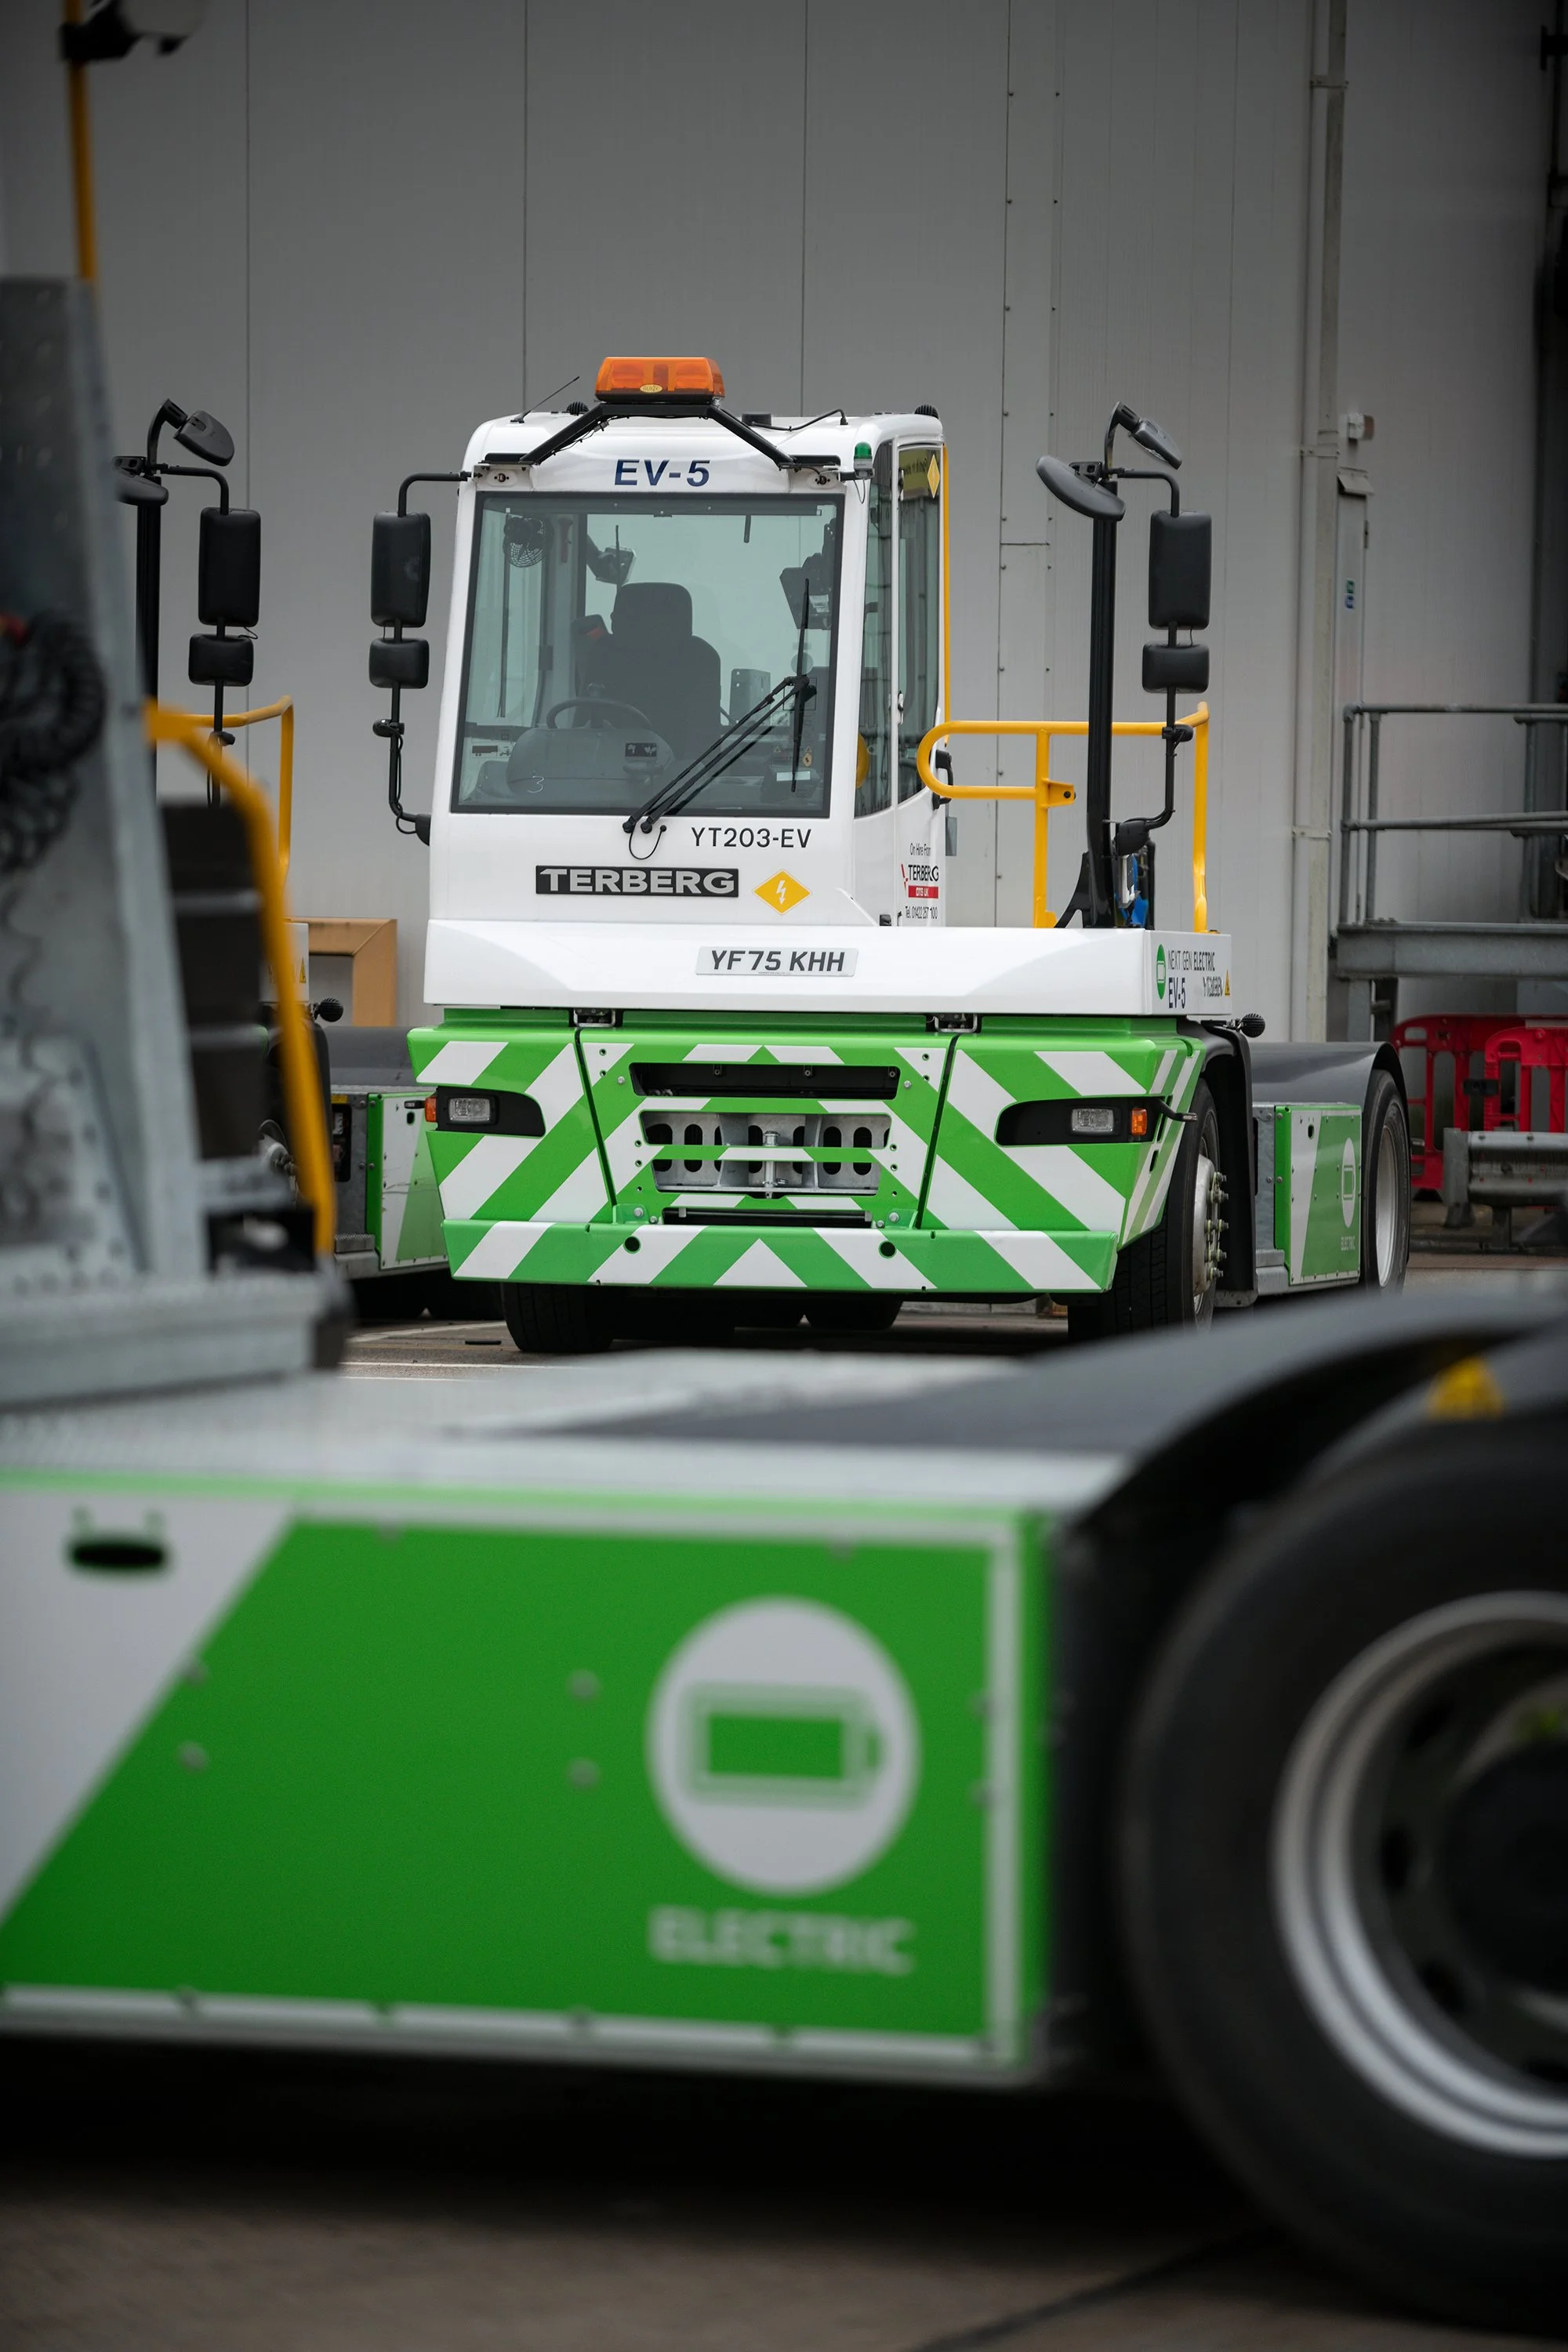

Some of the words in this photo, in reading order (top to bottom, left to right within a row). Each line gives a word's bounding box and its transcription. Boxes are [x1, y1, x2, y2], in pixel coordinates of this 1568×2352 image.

[615, 459, 710, 487] EV-5
[691, 827, 812, 848] YT203-EV
[539, 868, 735, 894] TERBERG
[908, 865, 939, 881] TERBERG
[711, 949, 782, 971] YF75
[789, 951, 845, 972] KHH
[1168, 949, 1181, 970] NEXT
[1182, 950, 1192, 971] GEN
[1193, 951, 1215, 971] ELECTRIC
[1168, 977, 1186, 1009] EV-5
[649, 1905, 916, 1975] ELECTRIC
